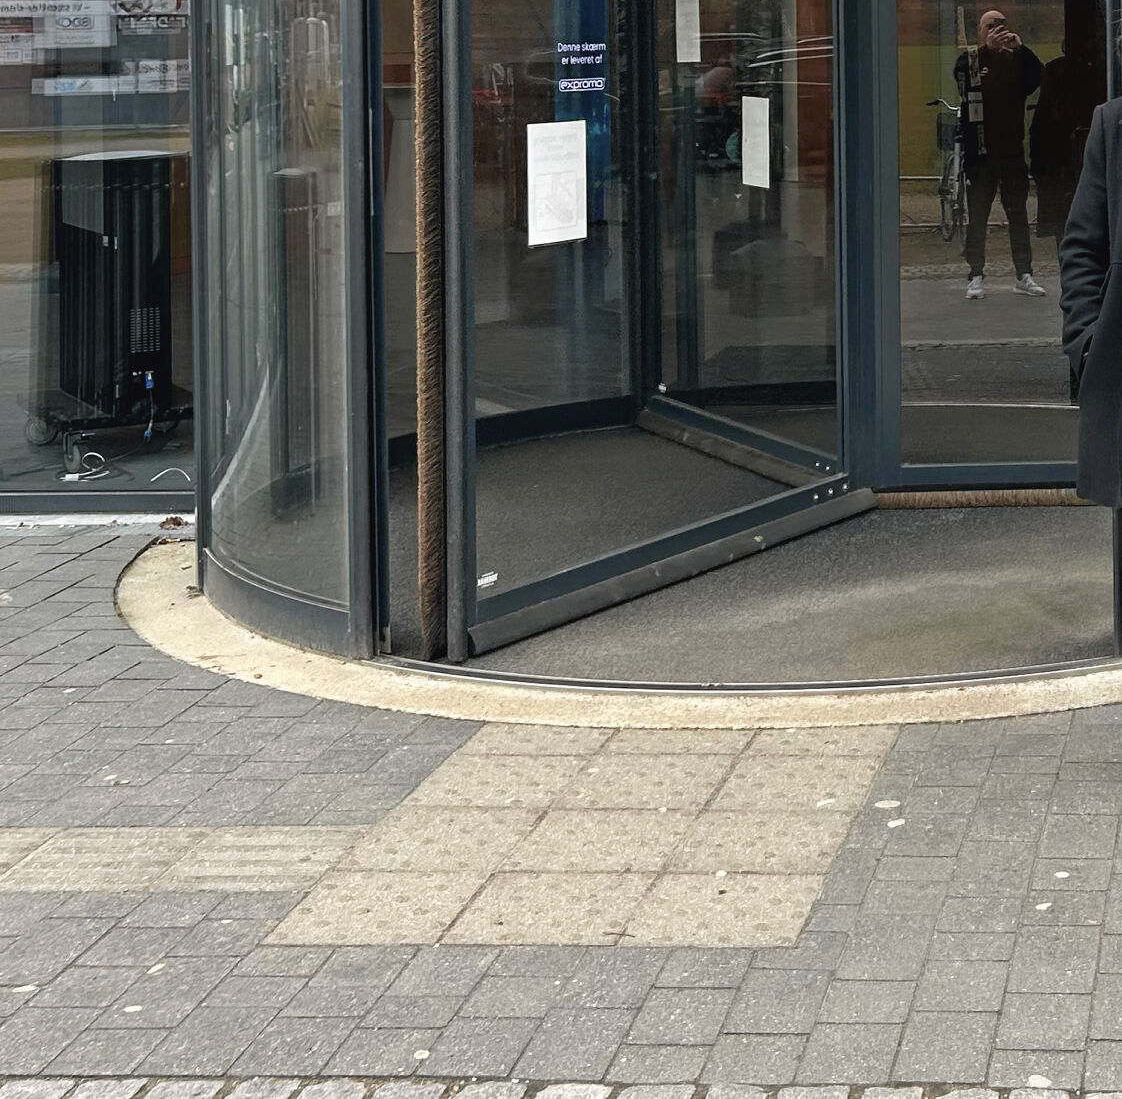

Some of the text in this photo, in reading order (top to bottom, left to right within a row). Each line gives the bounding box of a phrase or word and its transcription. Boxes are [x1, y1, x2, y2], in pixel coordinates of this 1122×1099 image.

[557, 42, 606, 52] Denne skærm
[561, 54, 603, 65] er leveret af
[560, 79, 604, 90] expromo
